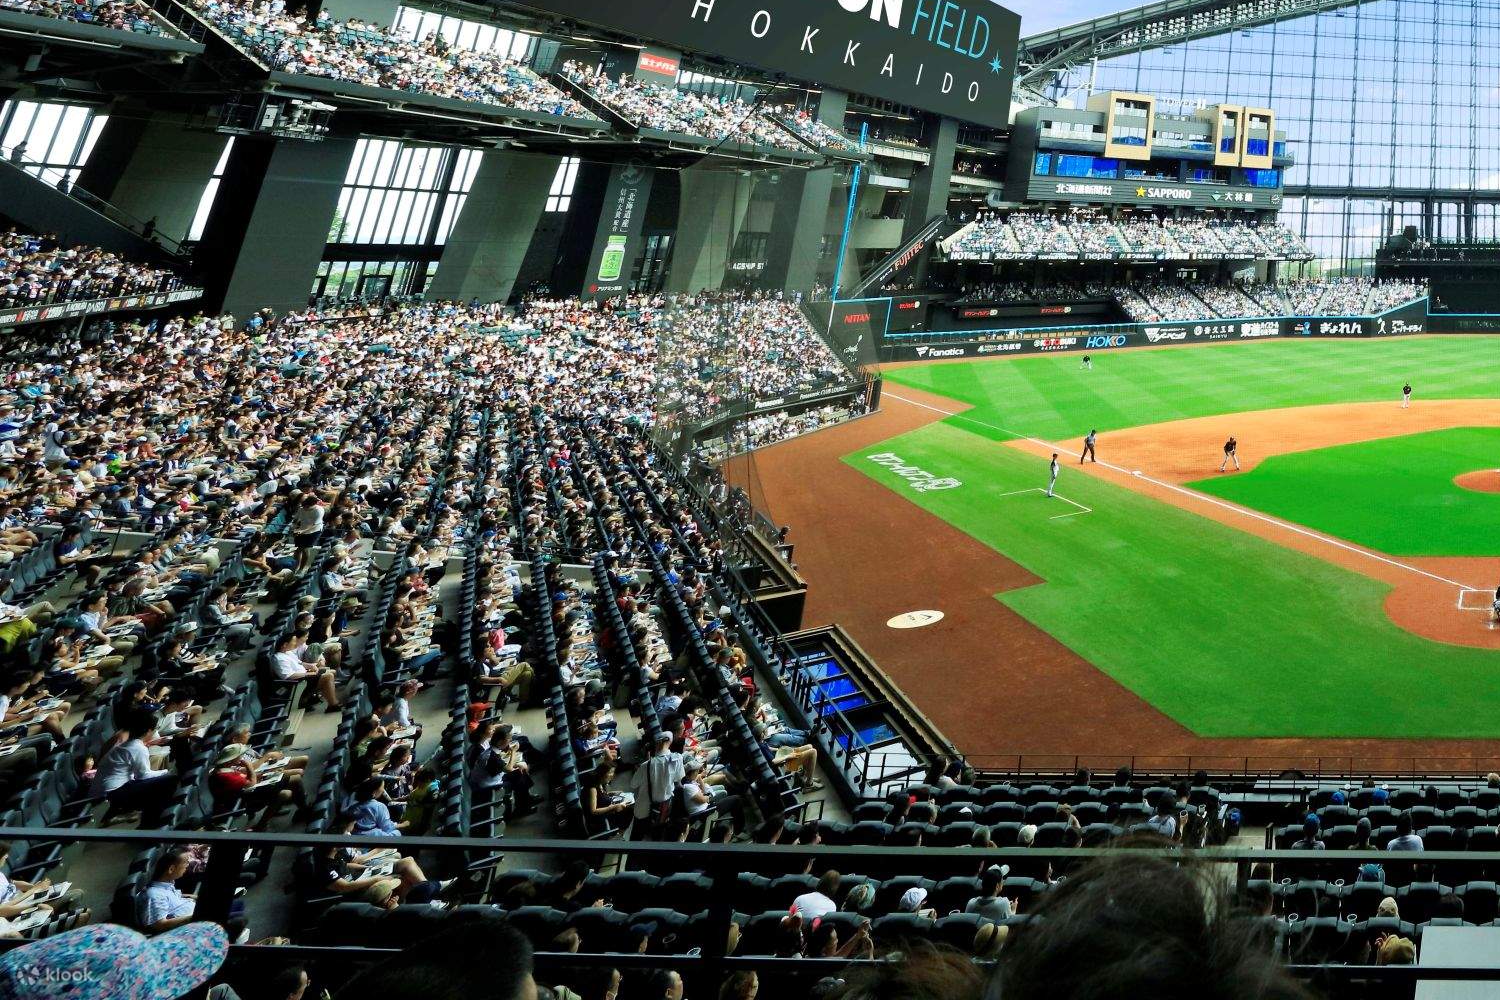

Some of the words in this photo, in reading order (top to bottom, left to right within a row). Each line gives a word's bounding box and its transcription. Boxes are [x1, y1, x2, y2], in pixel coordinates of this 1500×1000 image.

[1055, 183, 1112, 197] 北海道新聞社
[1147, 187, 1192, 200] SAPPORO
[894, 240, 925, 271] FUJITEC
[1084, 252, 1112, 261] nepia
[844, 313, 871, 324] NITTAN
[1319, 321, 1363, 335] ぎょれん
[928, 347, 965, 358] Fanatics
